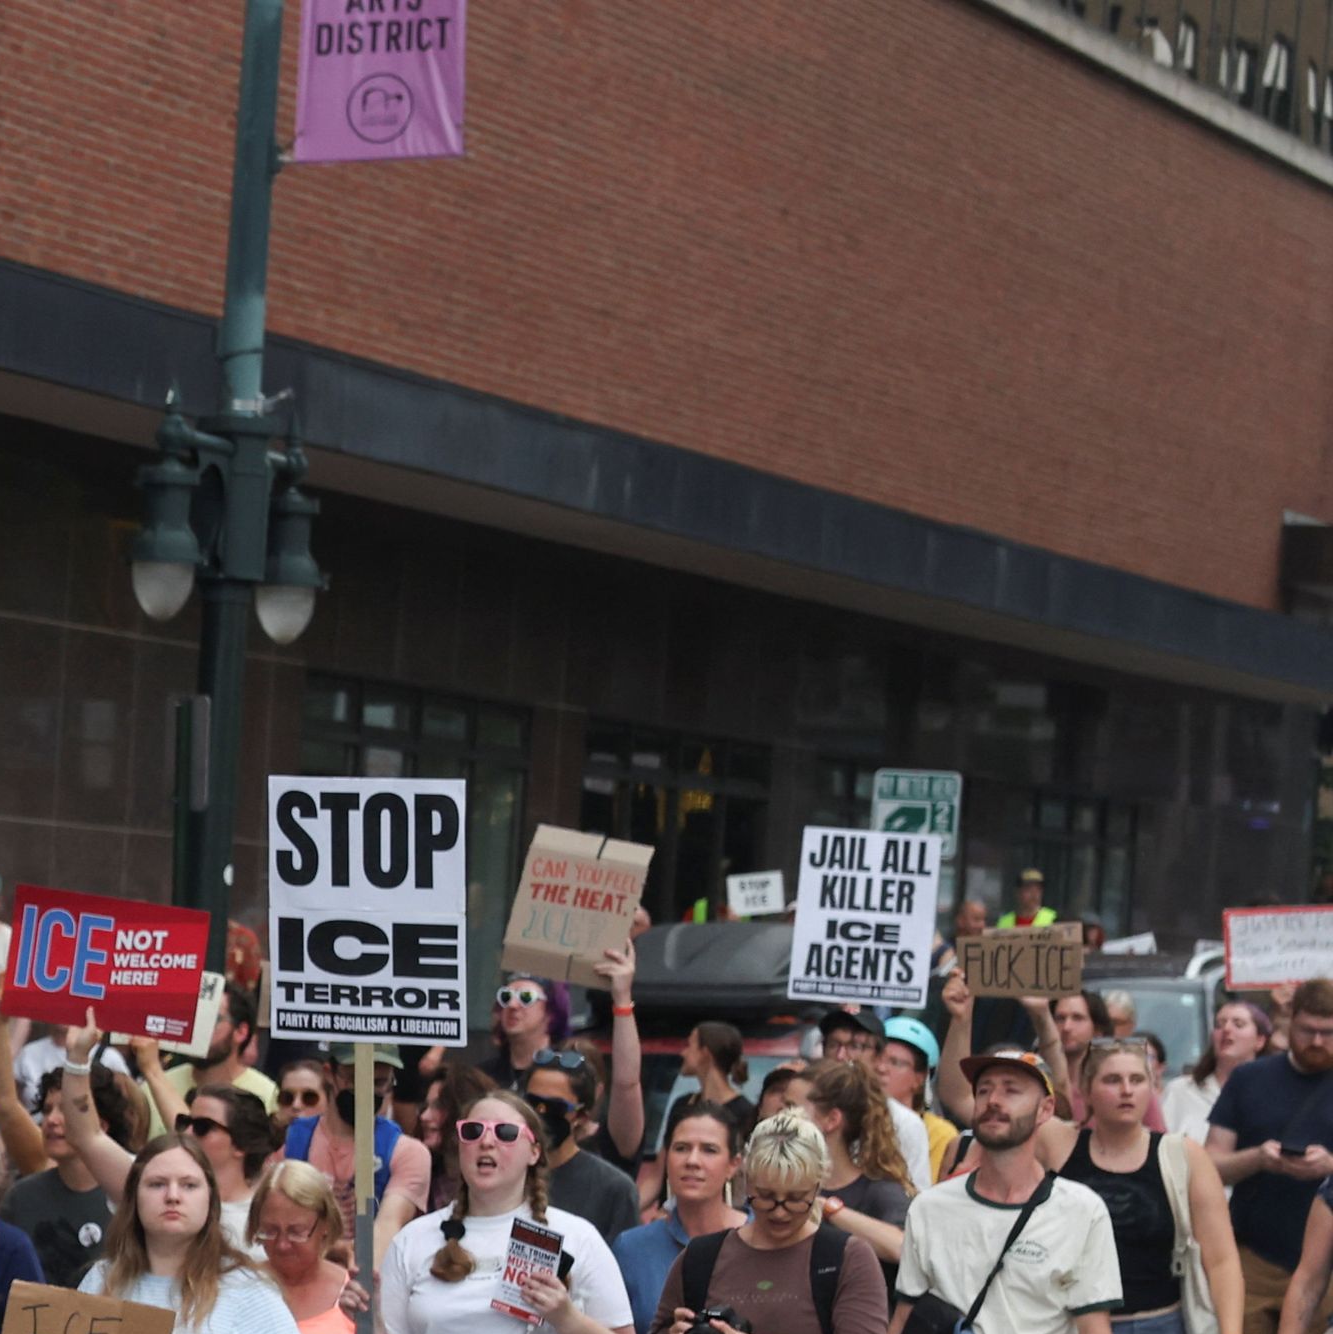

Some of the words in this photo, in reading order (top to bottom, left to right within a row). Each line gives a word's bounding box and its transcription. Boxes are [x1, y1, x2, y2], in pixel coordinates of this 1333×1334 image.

[316, 17, 450, 56] DISTRICT
[276, 790, 460, 889] STOP
[809, 835, 870, 872] JAIL
[880, 840, 931, 875] ALL
[531, 859, 568, 878] CAN
[575, 862, 603, 885] YOU
[530, 883, 569, 905] THE
[820, 875, 916, 915] KILLER
[115, 929, 168, 951] NOT
[826, 920, 901, 944] ICE
[14, 904, 115, 1000] ICE
[113, 952, 197, 969] WELCOME
[277, 917, 459, 980] ICE
[804, 943, 915, 983] AGENTS
[110, 970, 159, 986] HERE!
[964, 943, 1025, 989] FUCK
[1029, 945, 1074, 991] ICE
[276, 981, 460, 1011] TERROR
[279, 1012, 310, 1029] PARTY
[311, 1013, 331, 1030] FOR
[333, 1015, 389, 1032] SOCIALISM
[390, 1018, 398, 1032] &
[400, 1019, 458, 1036] LIBERATION
[507, 1255, 535, 1271] MUST
